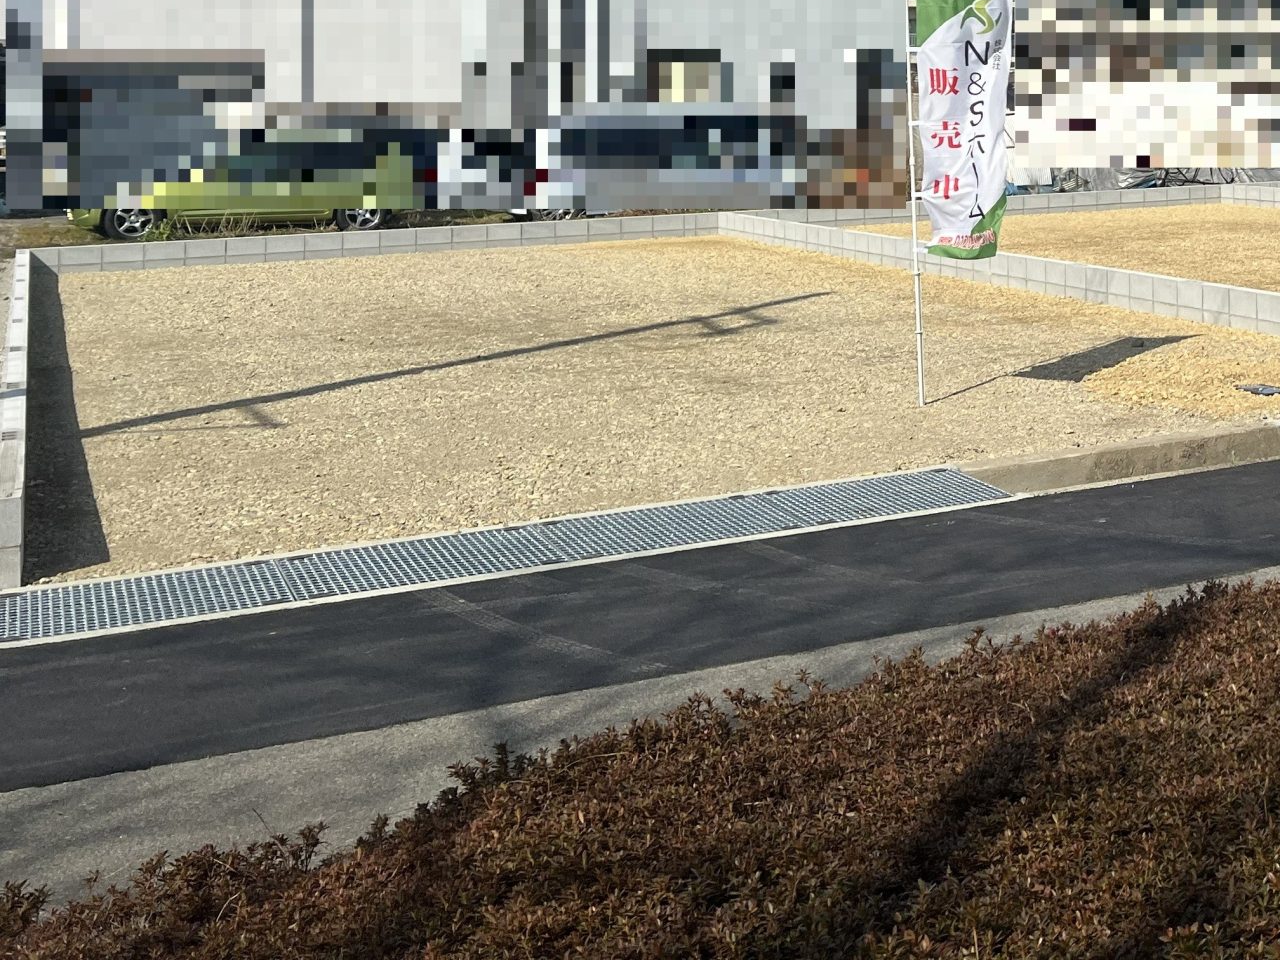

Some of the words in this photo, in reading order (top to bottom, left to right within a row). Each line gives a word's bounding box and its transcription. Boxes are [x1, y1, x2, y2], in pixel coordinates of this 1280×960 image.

[929, 68, 962, 200] 販売中
[965, 40, 990, 219] N&Sホーム
